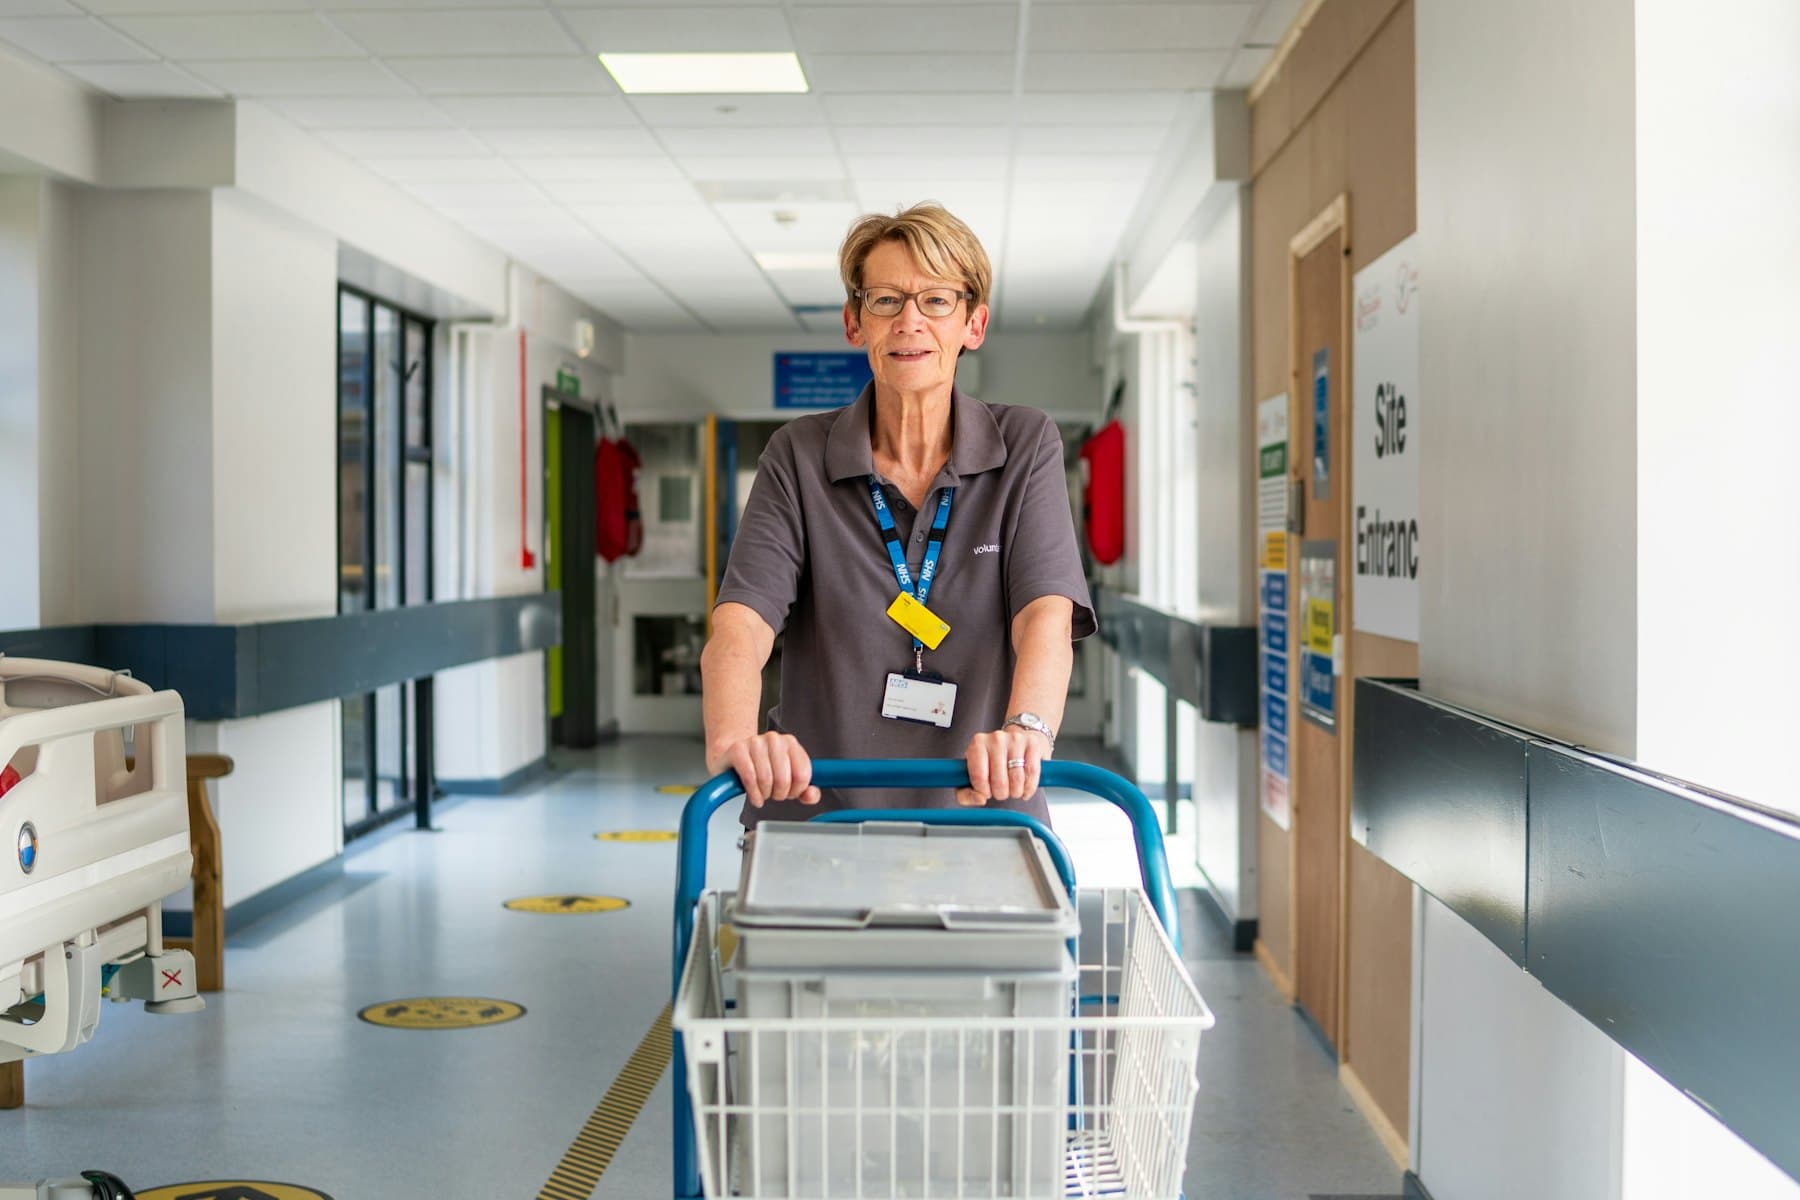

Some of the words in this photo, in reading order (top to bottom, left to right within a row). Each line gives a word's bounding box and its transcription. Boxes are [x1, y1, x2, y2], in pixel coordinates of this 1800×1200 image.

[1375, 382, 1407, 459] Site
[872, 490, 886, 511] NHS
[896, 563, 911, 585] NHS
[922, 559, 934, 581] NHS
[917, 587, 927, 604] HS
